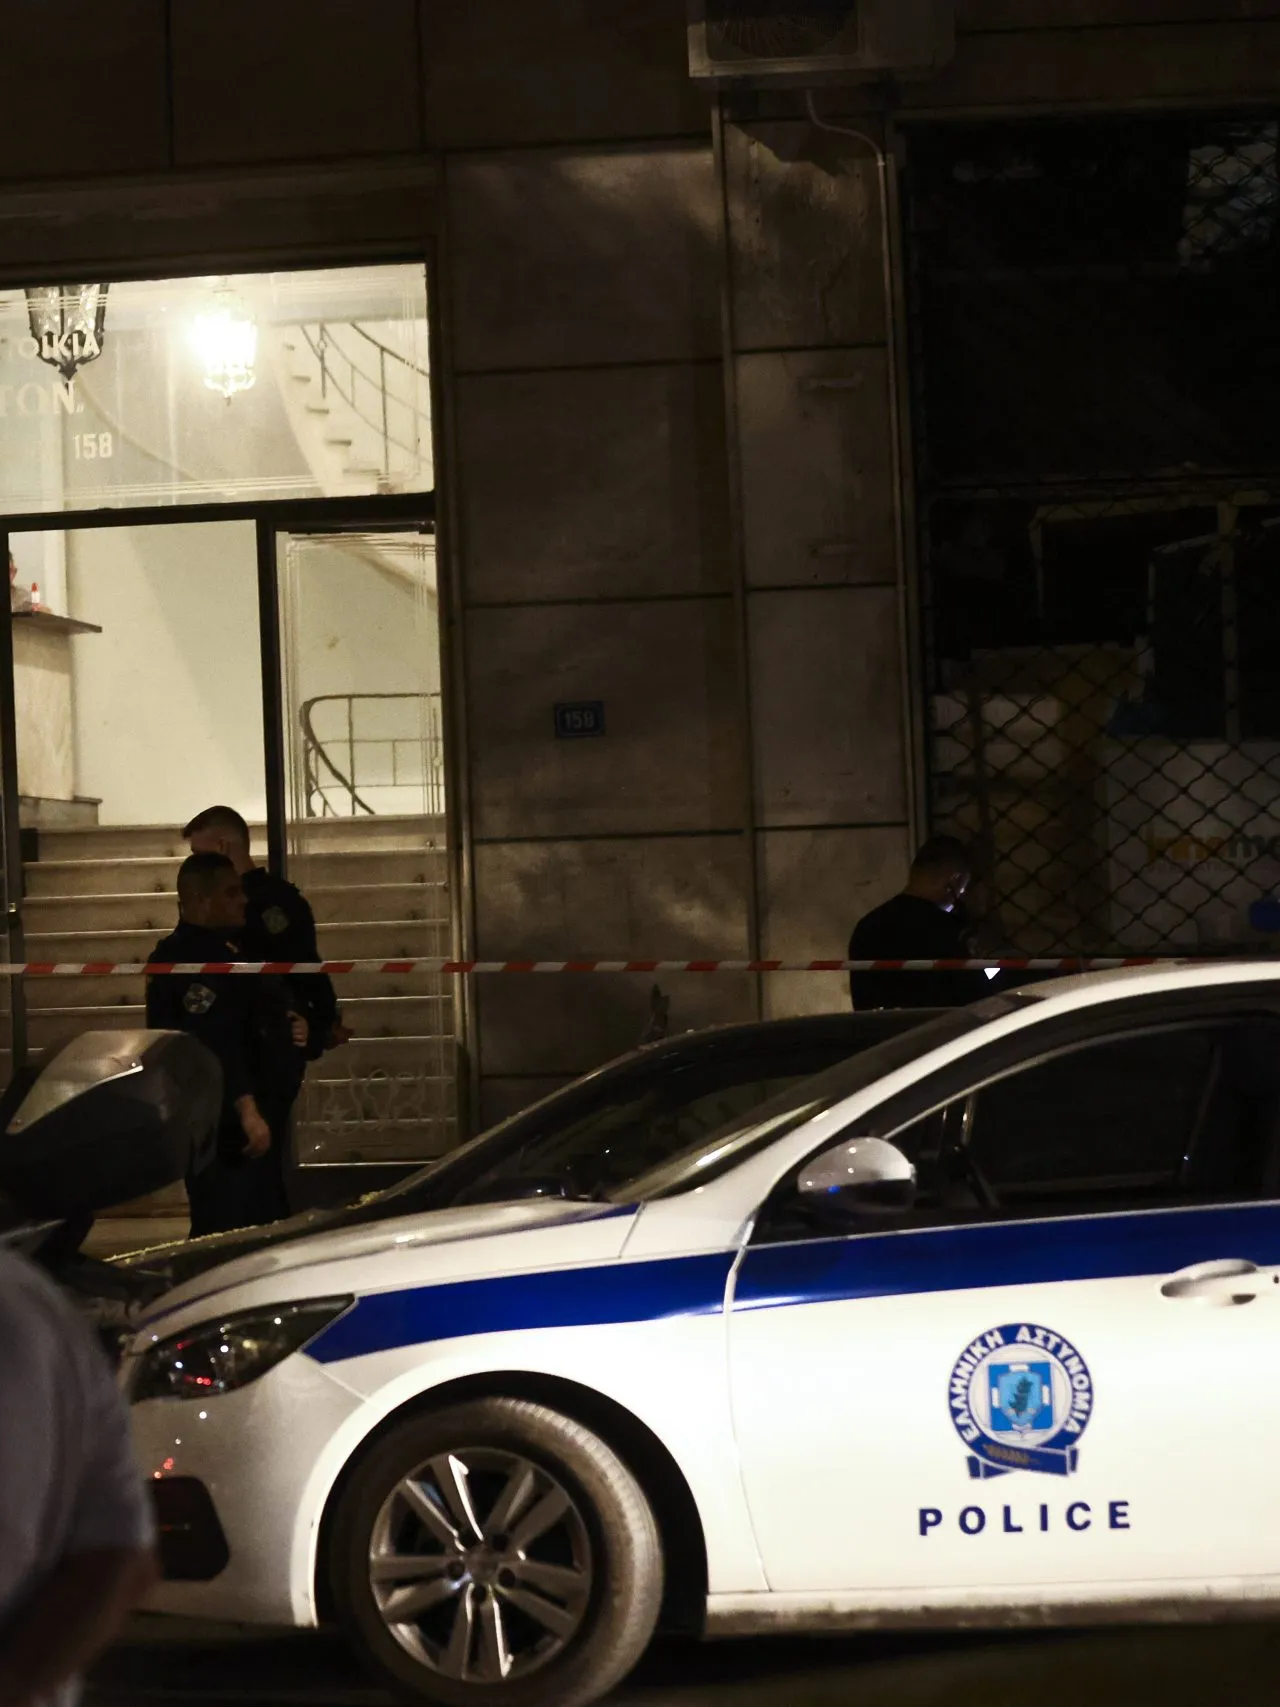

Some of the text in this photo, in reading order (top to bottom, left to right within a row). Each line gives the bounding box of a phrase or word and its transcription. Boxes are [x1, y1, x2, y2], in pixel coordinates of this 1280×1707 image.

[73, 432, 113, 460] 158
[565, 710, 595, 729] 158
[949, 1324, 1091, 1443] ΕΛΛΗΝΙΚΗ ΑΣΤΥΝΟΜΙΑ
[918, 1500, 1131, 1537] POLICE
